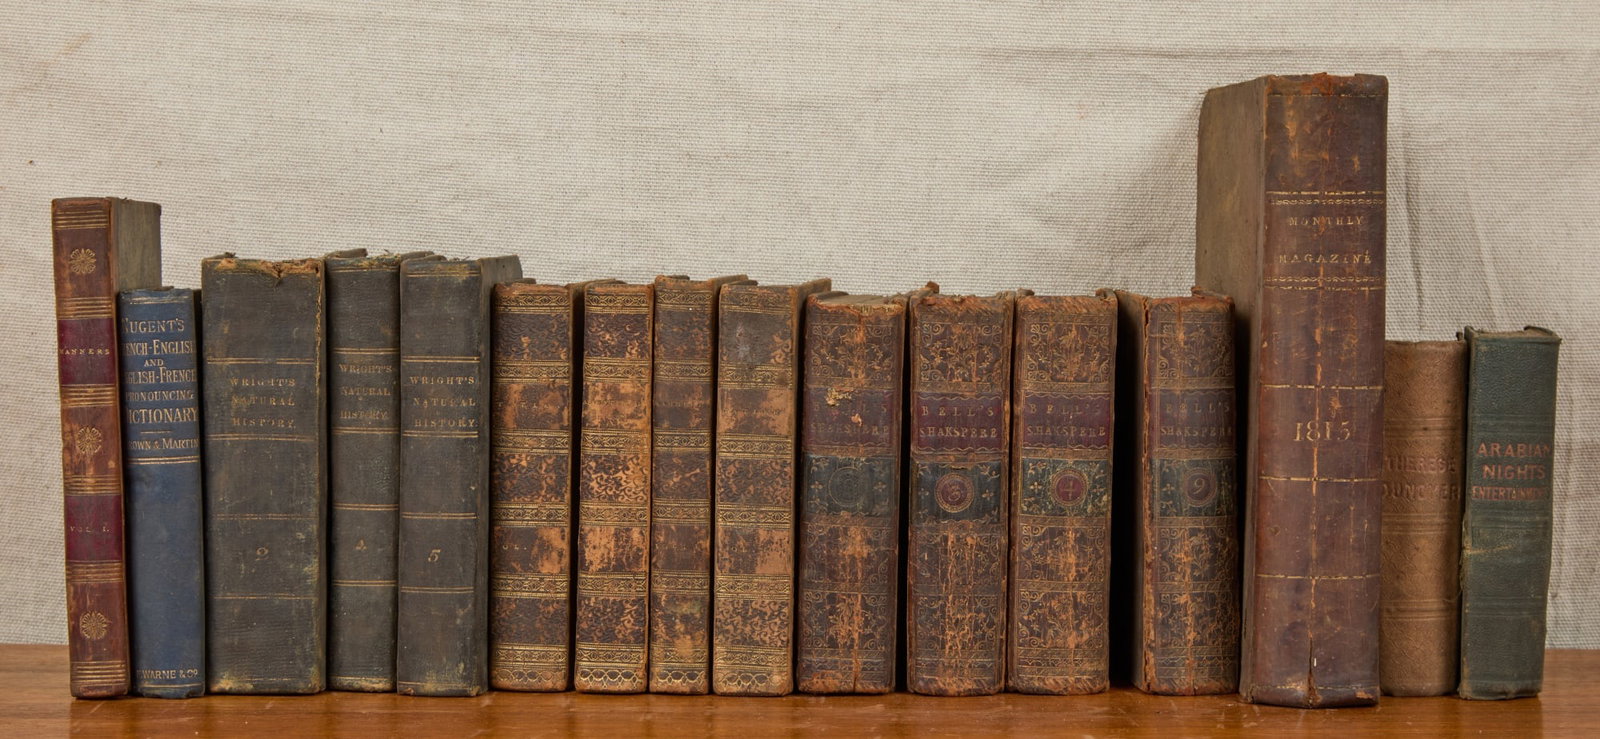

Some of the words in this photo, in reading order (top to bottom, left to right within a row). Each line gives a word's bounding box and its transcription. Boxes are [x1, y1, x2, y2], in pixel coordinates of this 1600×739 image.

[1289, 215, 1364, 226] MONTHLY
[1279, 253, 1372, 264] MAGAZINE
[143, 358, 164, 367] AND
[339, 363, 392, 374] WRIGHT'S
[409, 376, 476, 385] WRIGHT'S
[413, 398, 476, 408] NATURAL
[129, 407, 199, 424] ICTIONARY
[921, 405, 995, 417] BELL'S
[919, 426, 997, 438] SHAKSPERE
[1294, 421, 1351, 441] 1815
[1481, 463, 1547, 481] NIGHTS
[427, 548, 442, 563] 5
